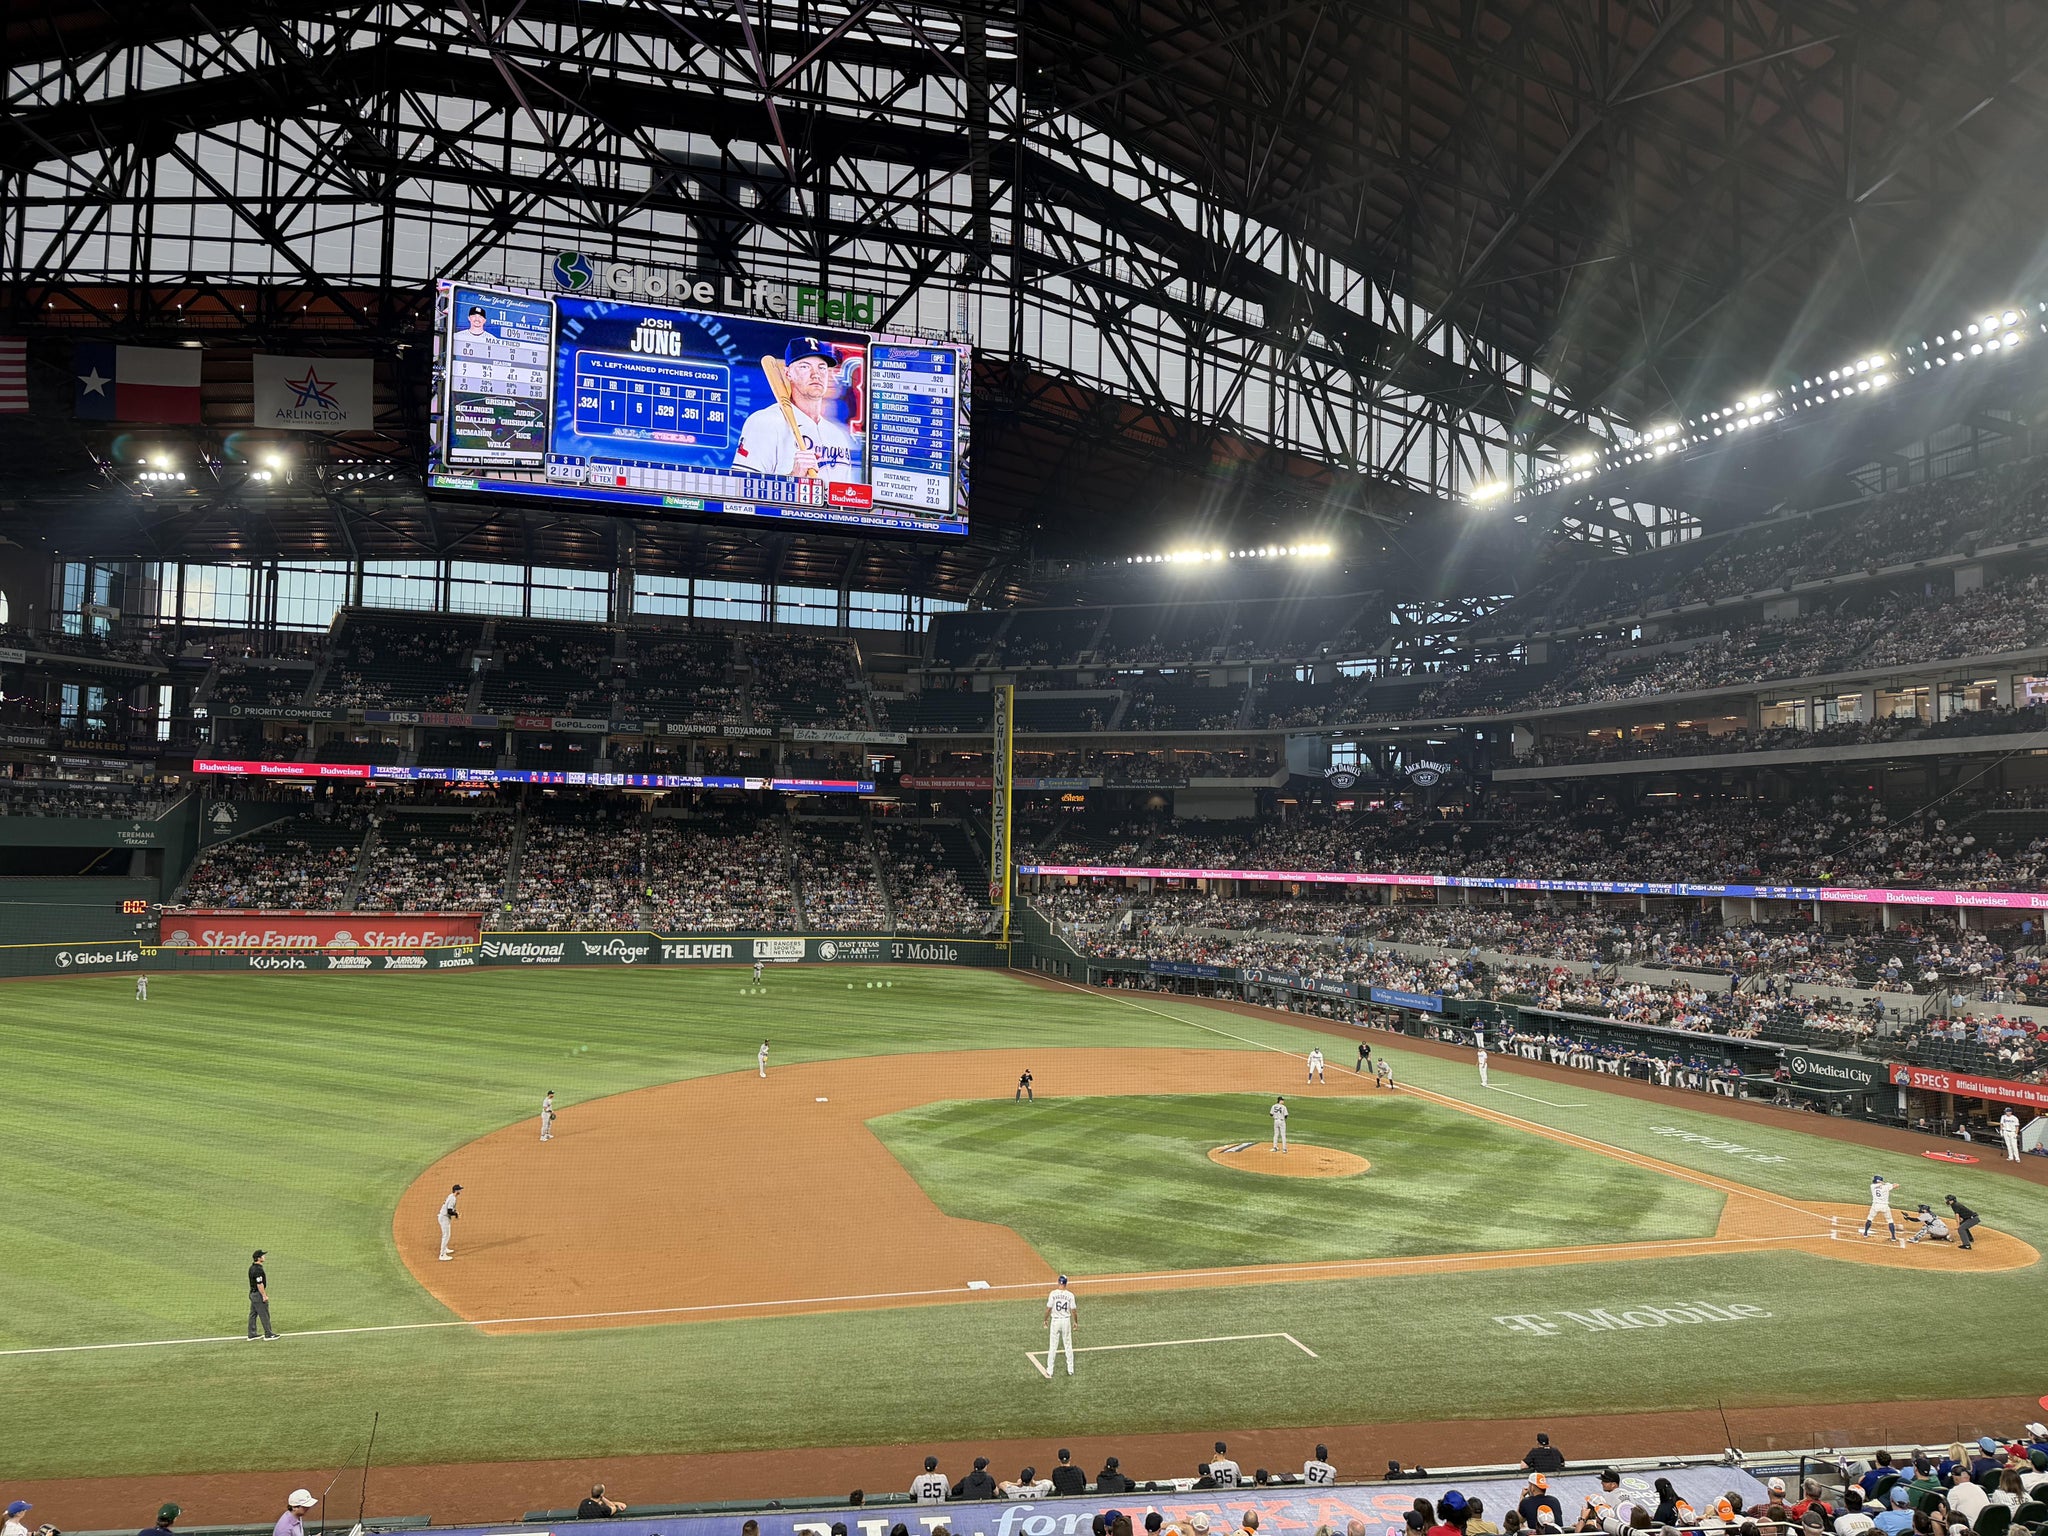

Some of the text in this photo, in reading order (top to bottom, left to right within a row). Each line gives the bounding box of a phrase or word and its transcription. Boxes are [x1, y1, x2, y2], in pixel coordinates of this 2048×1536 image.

[606, 262, 875, 324] Globe Life Field
[640, 317, 673, 330] JOSH
[507, 329, 521, 338] 0%
[501, 340, 521, 348] FRIED
[630, 327, 682, 357] JUNG
[463, 348, 474, 356] 0.0
[591, 360, 719, 381] VS. LEFT-HANDED PITCHERS (2026)
[882, 361, 907, 369] NIMMO
[480, 385, 493, 393] 20.4
[583, 378, 722, 401] AVG HR SLG OBP OPS
[485, 399, 516, 407] GRISHAM
[882, 392, 909, 402] SEAGER
[455, 405, 535, 417] BELLINGER JUDGE
[578, 396, 725, 423] .324 5 .529 .351 .881
[882, 403, 909, 412] BURGER
[275, 408, 347, 420] ARLINGTON
[882, 413, 921, 424] MCCUTCHEN
[455, 415, 533, 428] CABALLERO CHISHOLM
[456, 428, 531, 440] MCMAHON RICE
[881, 424, 919, 435] HIGASHIOKA
[881, 435, 918, 445] HAGGERTY
[881, 445, 908, 455] CARTER
[598, 465, 613, 473] NYY
[881, 456, 942, 470] DURAN .712
[551, 466, 581, 478] 2 2 0
[446, 478, 474, 486] National
[600, 475, 612, 483] TEX
[883, 473, 940, 486] DISTANCE 117.1
[890, 482, 918, 492] VELOCITY
[674, 498, 701, 506] National
[831, 494, 869, 505] Budweiser
[894, 492, 914, 501] ANGLE
[926, 496, 940, 505] 23.0
[725, 504, 741, 512] LAST
[781, 509, 827, 520] BRANDON
[828, 513, 860, 523] NIMMO
[860, 517, 898, 527] SINGLED
[913, 522, 939, 530] THIRD
[244, 707, 332, 719] PRIORITY COMMERCE
[389, 713, 419, 723] 105.3
[422, 714, 445, 724] THE
[525, 719, 641, 732] PGL GoPGL.com PGL
[667, 723, 772, 737] BODYARMOR BODYARMOR
[7, 735, 46, 745] ROOFING
[795, 730, 819, 740] Blue
[823, 732, 851, 742] Mint
[64, 739, 127, 751] PLUCKERS
[996, 715, 1004, 786] CHIKIN
[199, 763, 363, 776] Budweiser Budweiser Budweiser
[1324, 765, 1338, 778] JACK
[1405, 762, 1420, 775] JACK
[996, 790, 1004, 818] IZ
[996, 826, 1004, 877] FARE
[1823, 891, 2008, 906] Budweiser Budweiser Budweiser
[123, 900, 147, 914] 0:02
[499, 942, 565, 956] National
[603, 938, 649, 964] Kroger
[908, 944, 957, 961] Mobile
[75, 950, 139, 965] Globe Life
[249, 956, 305, 969] Kubota
[338, 957, 365, 965] ARROW
[395, 957, 421, 965] ARROW
[439, 958, 475, 968] HONDA
[1267, 975, 1288, 985] American
[1320, 983, 1343, 994] American
[1809, 1062, 1872, 1085] Medical City
[1914, 1072, 2034, 1100] SPEC'S Official Liquor Store of the
[1056, 1301, 1068, 1312] 64
[1554, 1300, 1773, 1332] Mobile
[1215, 1469, 1233, 1484] 85
[1308, 1467, 1327, 1484] 67
[923, 1482, 942, 1498] 25
[992, 1505, 1093, 1536] for
